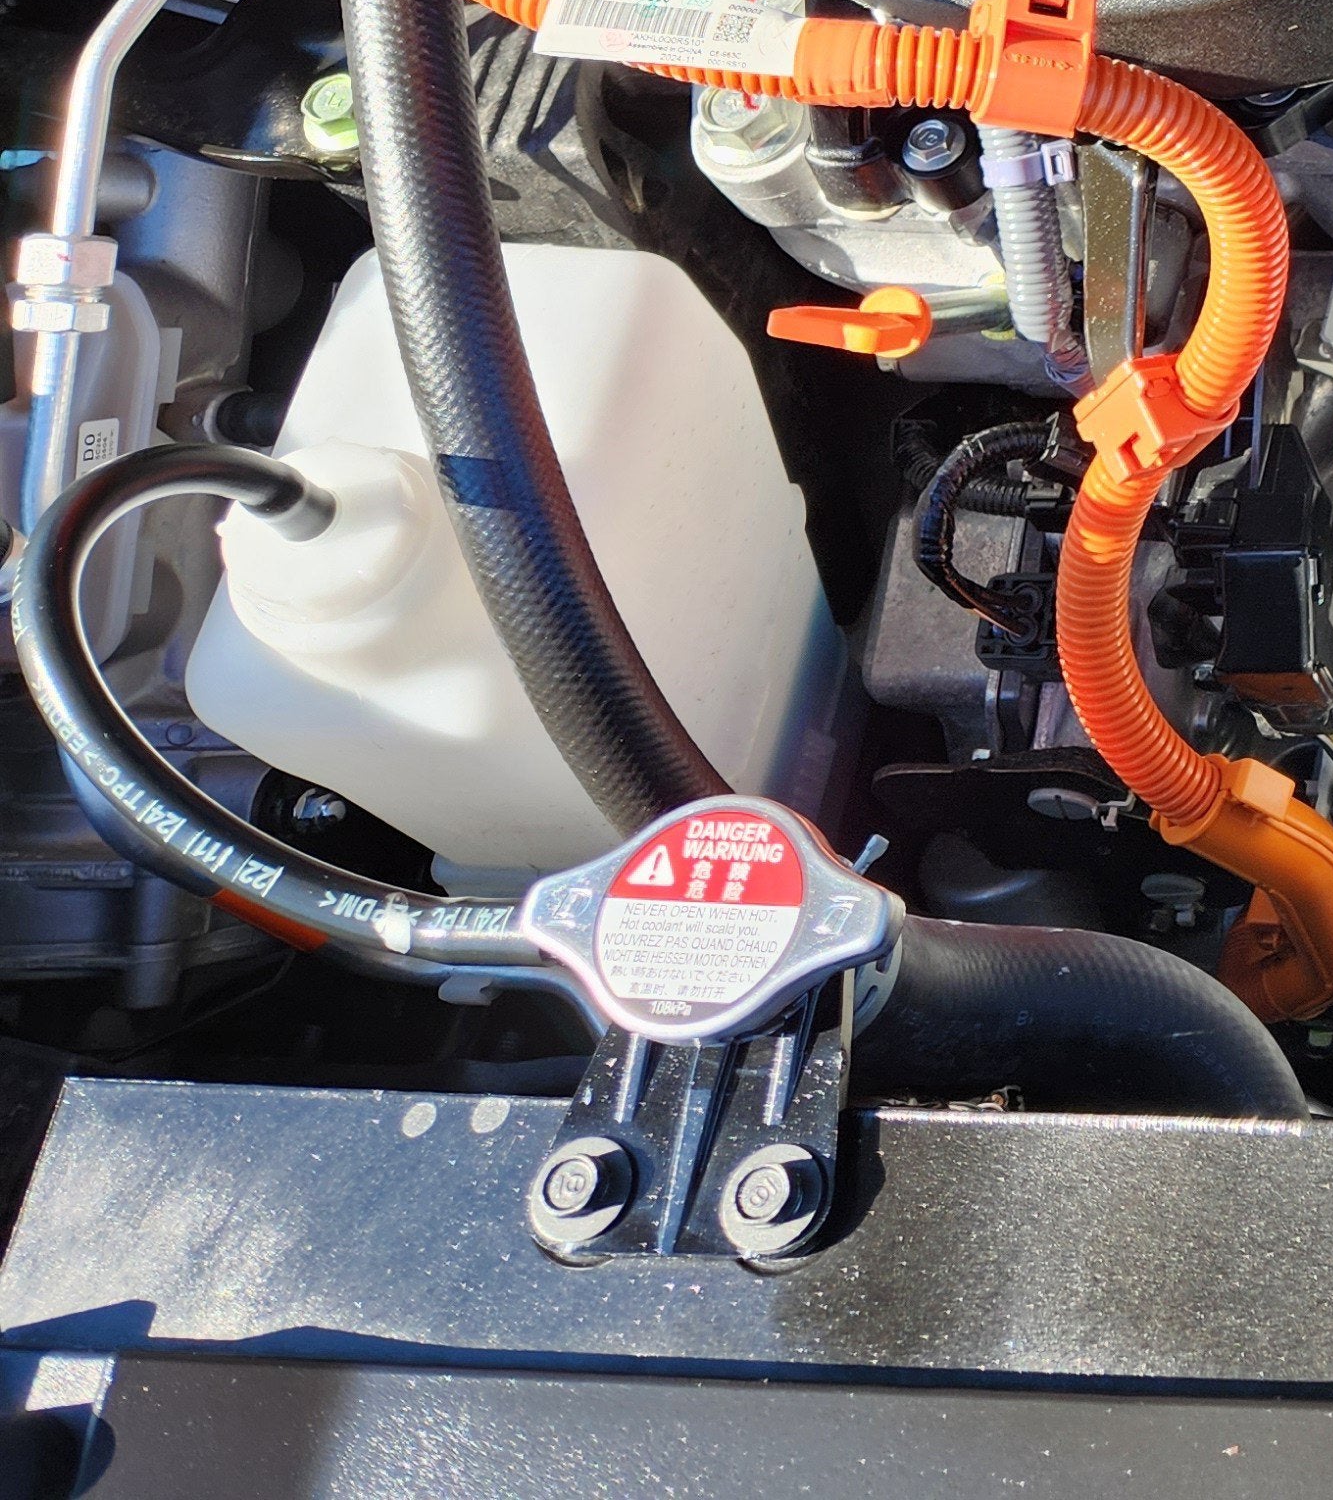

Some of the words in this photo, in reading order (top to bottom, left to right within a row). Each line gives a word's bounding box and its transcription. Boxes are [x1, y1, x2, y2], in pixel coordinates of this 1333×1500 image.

[686, 819, 772, 843] DANGER
[682, 839, 784, 864] WARNUNG
[624, 902, 668, 917] NEVER
[670, 904, 706, 919] OPEN
[709, 907, 747, 922] WHEN
[748, 909, 778, 924] HOT.
[619, 916, 640, 931] Hot
[642, 918, 683, 932] coolant
[684, 920, 704, 934] will
[704, 922, 736, 936] scald
[603, 932, 664, 948] N'OUVREZ
[664, 935, 689, 949] PAS
[604, 948, 634, 962] NICHT
[633, 950, 650, 963] BEI
[650, 951, 694, 965] HEISSEM
[693, 953, 730, 968] MOTOR
[651, 1000, 693, 1017] 108kPa
